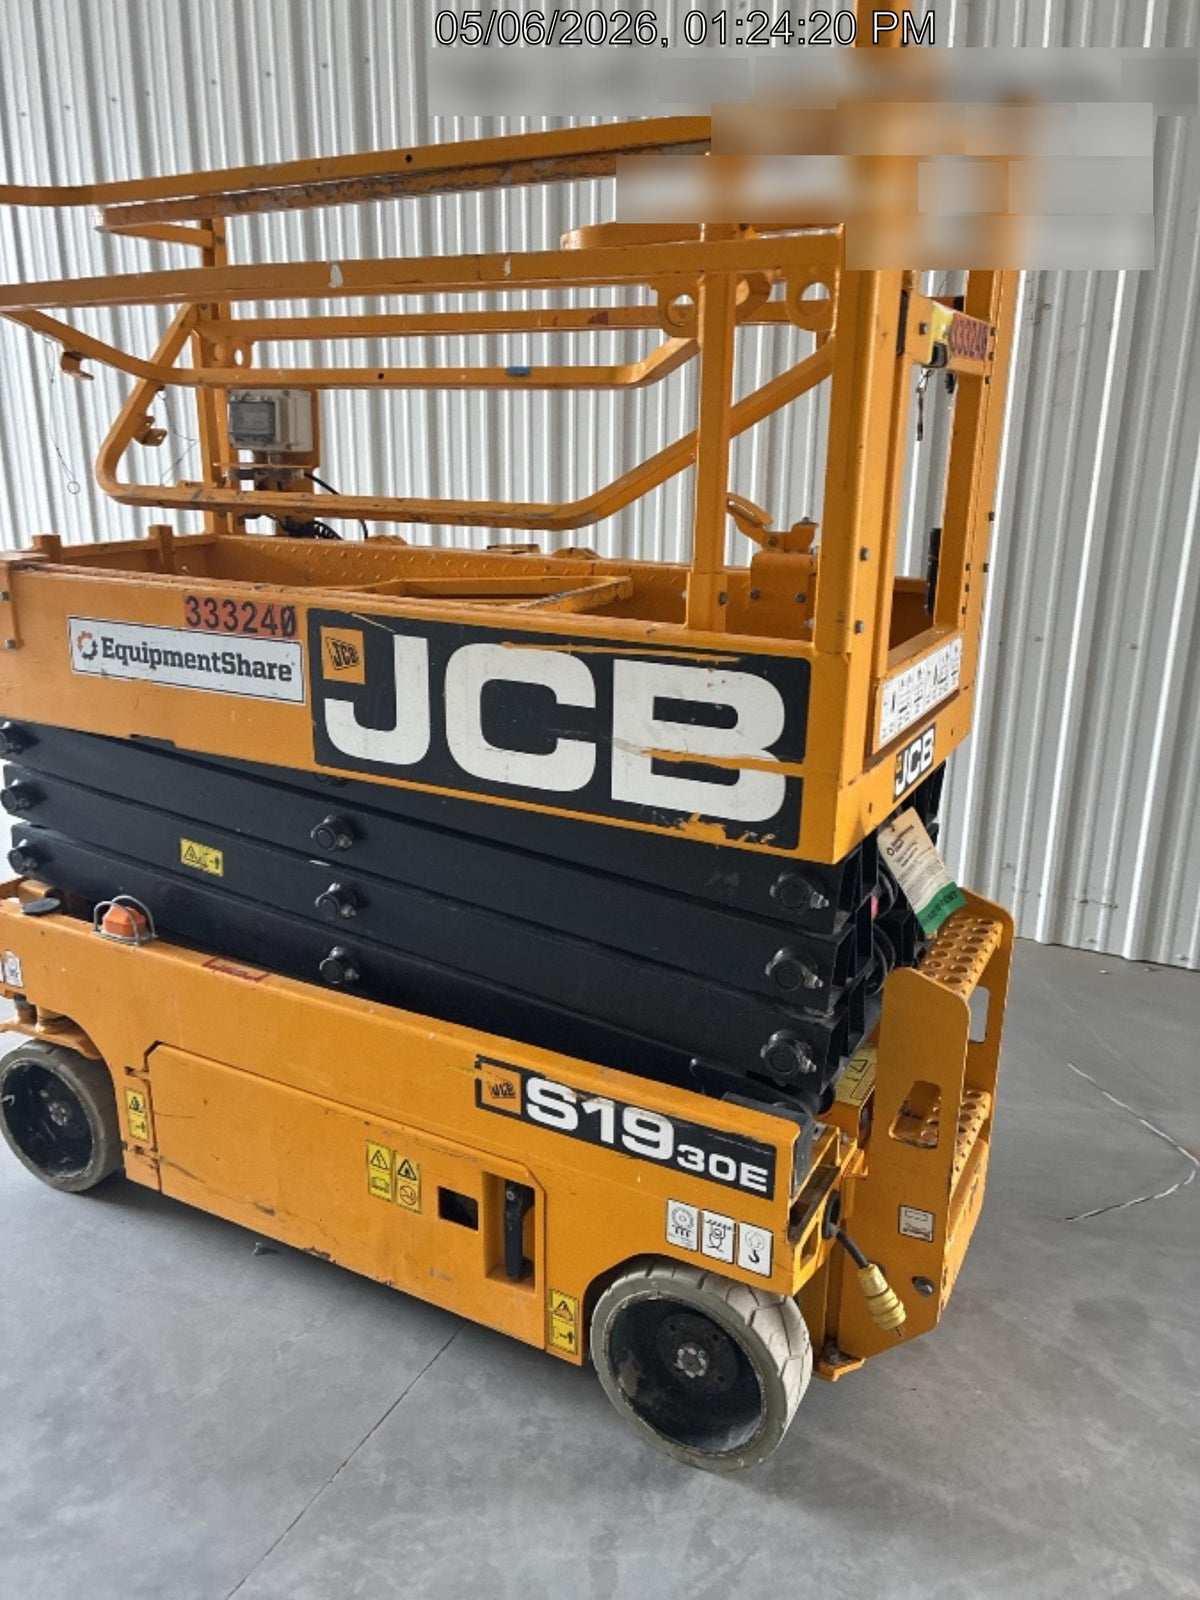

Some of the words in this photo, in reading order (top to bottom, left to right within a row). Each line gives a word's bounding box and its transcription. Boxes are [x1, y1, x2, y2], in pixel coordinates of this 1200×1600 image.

[101, 636, 293, 683] EquipmentShare
[324, 634, 786, 823] JCB
[895, 728, 935, 797] JCB
